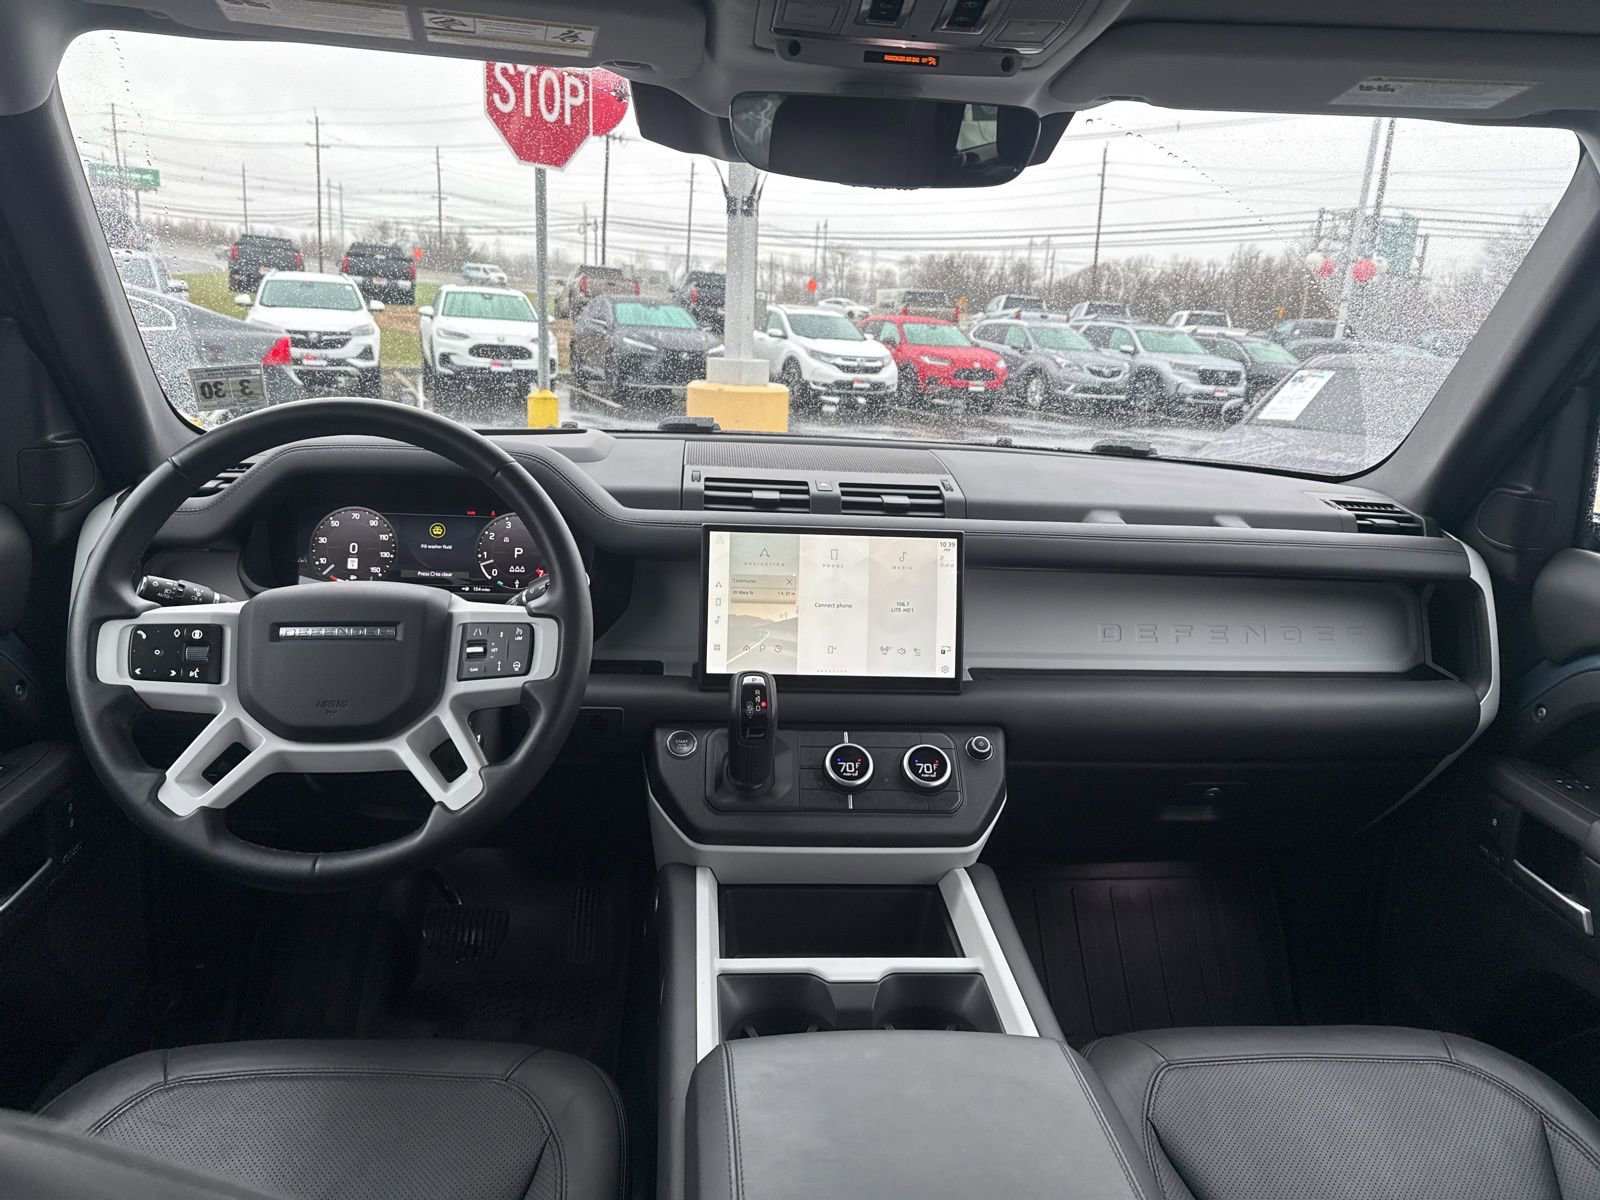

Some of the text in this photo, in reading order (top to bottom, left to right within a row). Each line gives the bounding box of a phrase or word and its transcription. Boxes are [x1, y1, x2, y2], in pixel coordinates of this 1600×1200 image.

[492, 61, 585, 126] STOP
[350, 542, 358, 554] 0
[514, 547, 524, 558] P
[492, 568, 498, 576] 0
[1099, 623, 1371, 645] DEFENDER
[316, 700, 348, 708] AIRBAG
